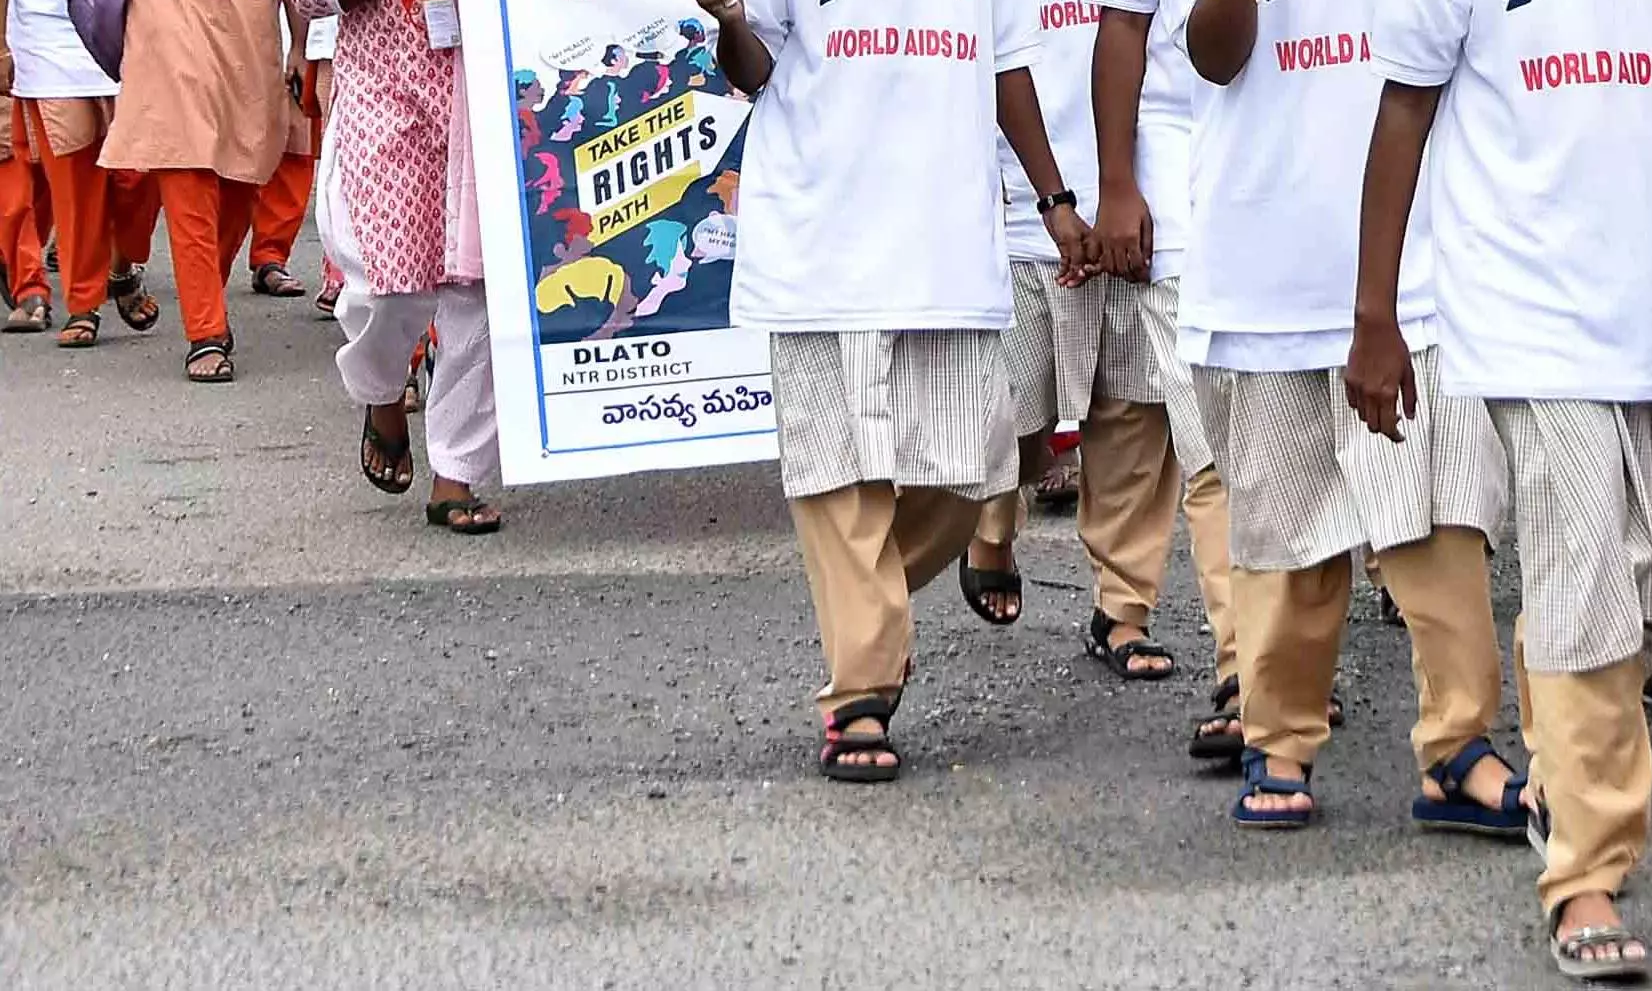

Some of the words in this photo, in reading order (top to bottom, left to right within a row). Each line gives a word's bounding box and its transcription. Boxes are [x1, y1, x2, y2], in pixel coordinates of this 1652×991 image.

[826, 27, 897, 59] WORLD
[904, 28, 953, 58] AIDS
[957, 32, 978, 62] DA
[1276, 33, 1353, 72] WORLD
[1520, 49, 1612, 92] WORLD
[587, 125, 642, 163] TAKE
[645, 100, 687, 138] THE
[592, 115, 717, 205] RIGHTS
[598, 197, 650, 235] PATH
[574, 340, 671, 365] DLATO
[563, 370, 599, 385] NTR
[606, 361, 693, 382] DISTRICT
[602, 394, 697, 428] వాసవ్య
[702, 385, 773, 415] మహి
